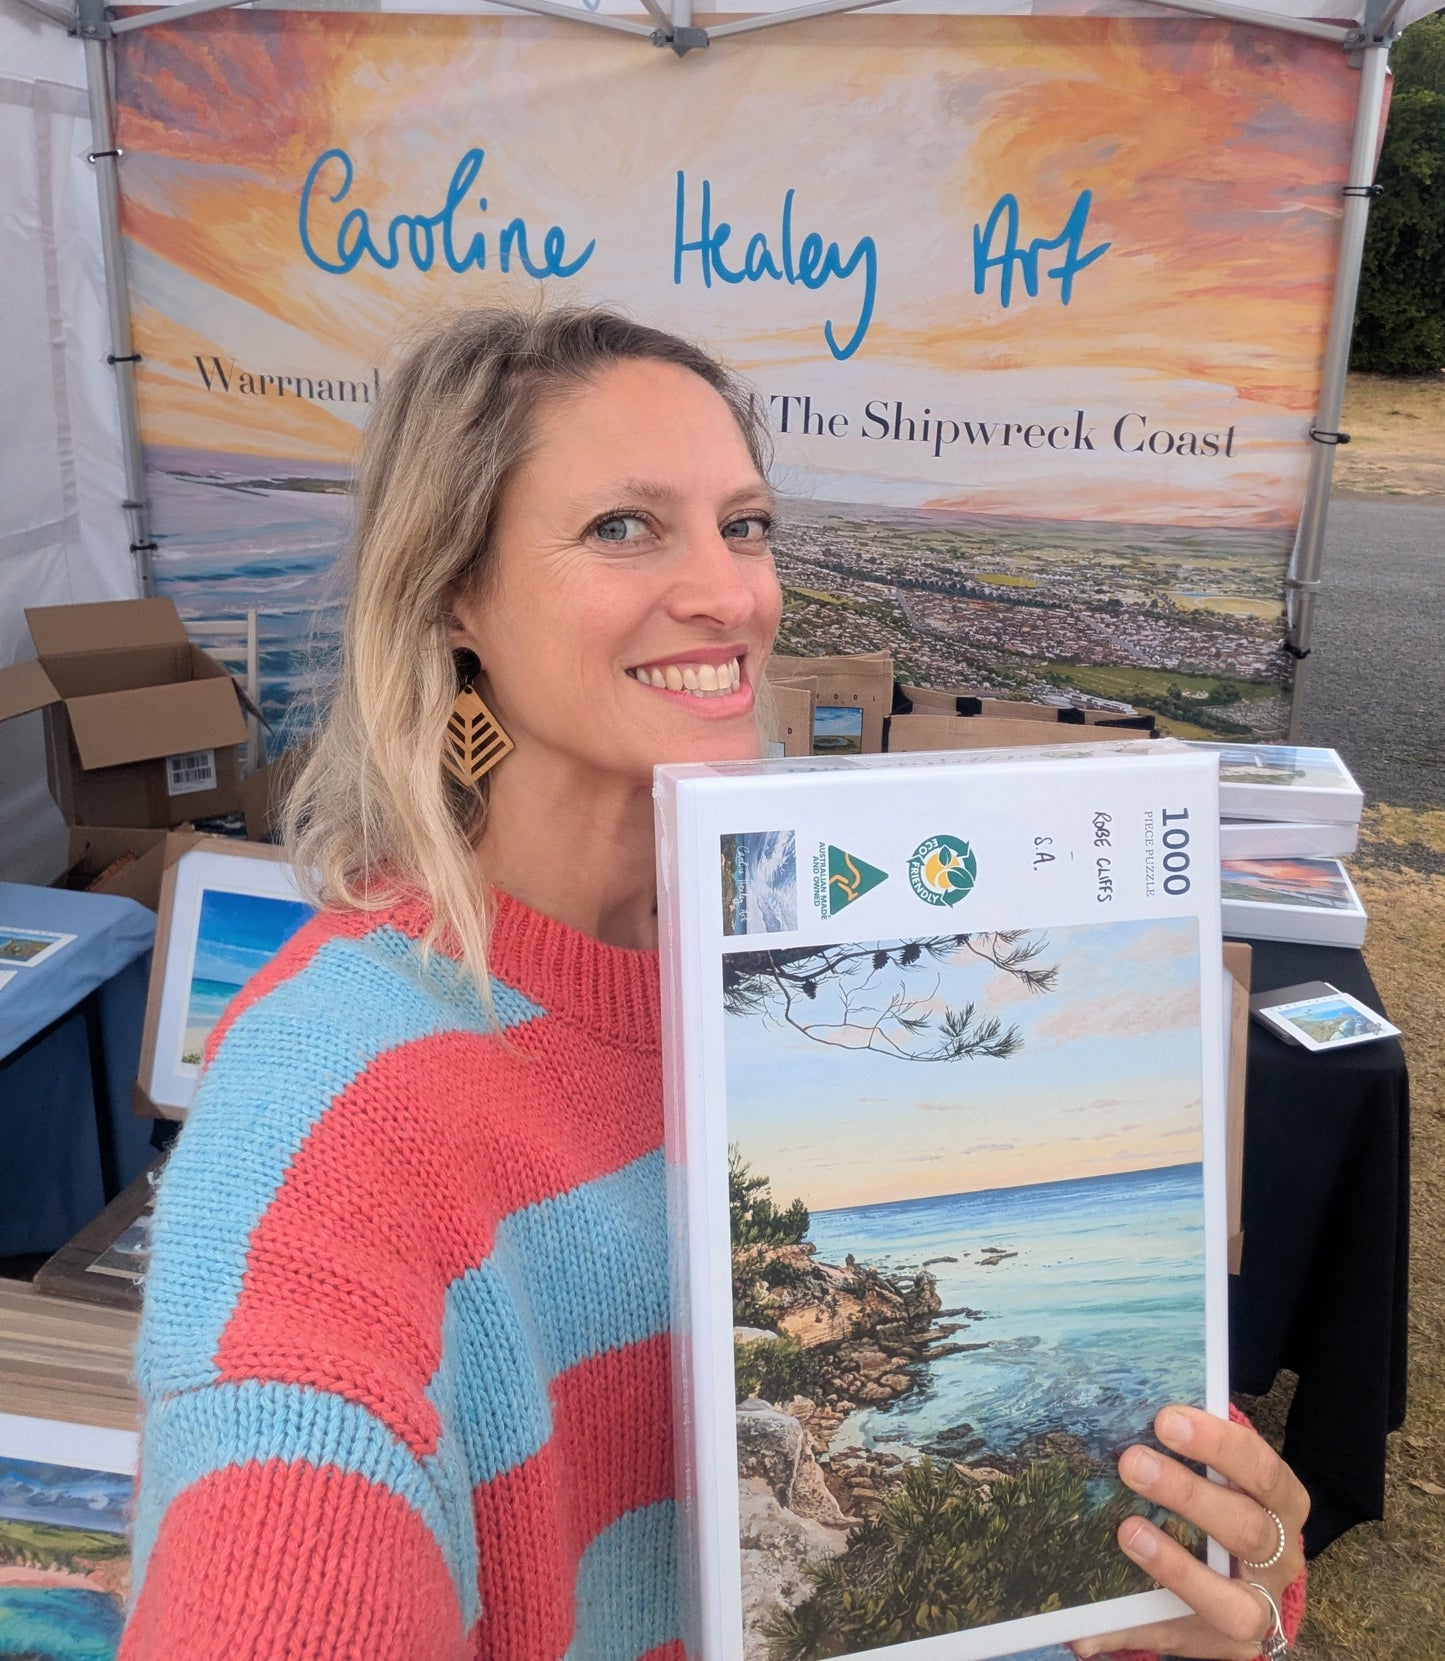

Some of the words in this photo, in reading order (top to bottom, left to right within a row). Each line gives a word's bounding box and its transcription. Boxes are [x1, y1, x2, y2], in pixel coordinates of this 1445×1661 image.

[299, 148, 596, 279] Caroline
[674, 170, 877, 360] Healey
[974, 189, 1112, 307] Art
[770, 395, 848, 437] The
[861, 400, 1098, 457] Shipwreck
[1113, 413, 1239, 457] Coast
[918, 838, 939, 855] ECO
[1092, 812, 1112, 847] ROBE
[1144, 811, 1154, 847] PIECE
[1162, 808, 1191, 895] 1000
[819, 841, 827, 892] AUSTRALIAN
[1033, 836, 1056, 871] S.A.
[1145, 849, 1155, 897] PUZZLE
[910, 861, 939, 904] FRIENDLY
[1096, 858, 1113, 903] CLIFFS
